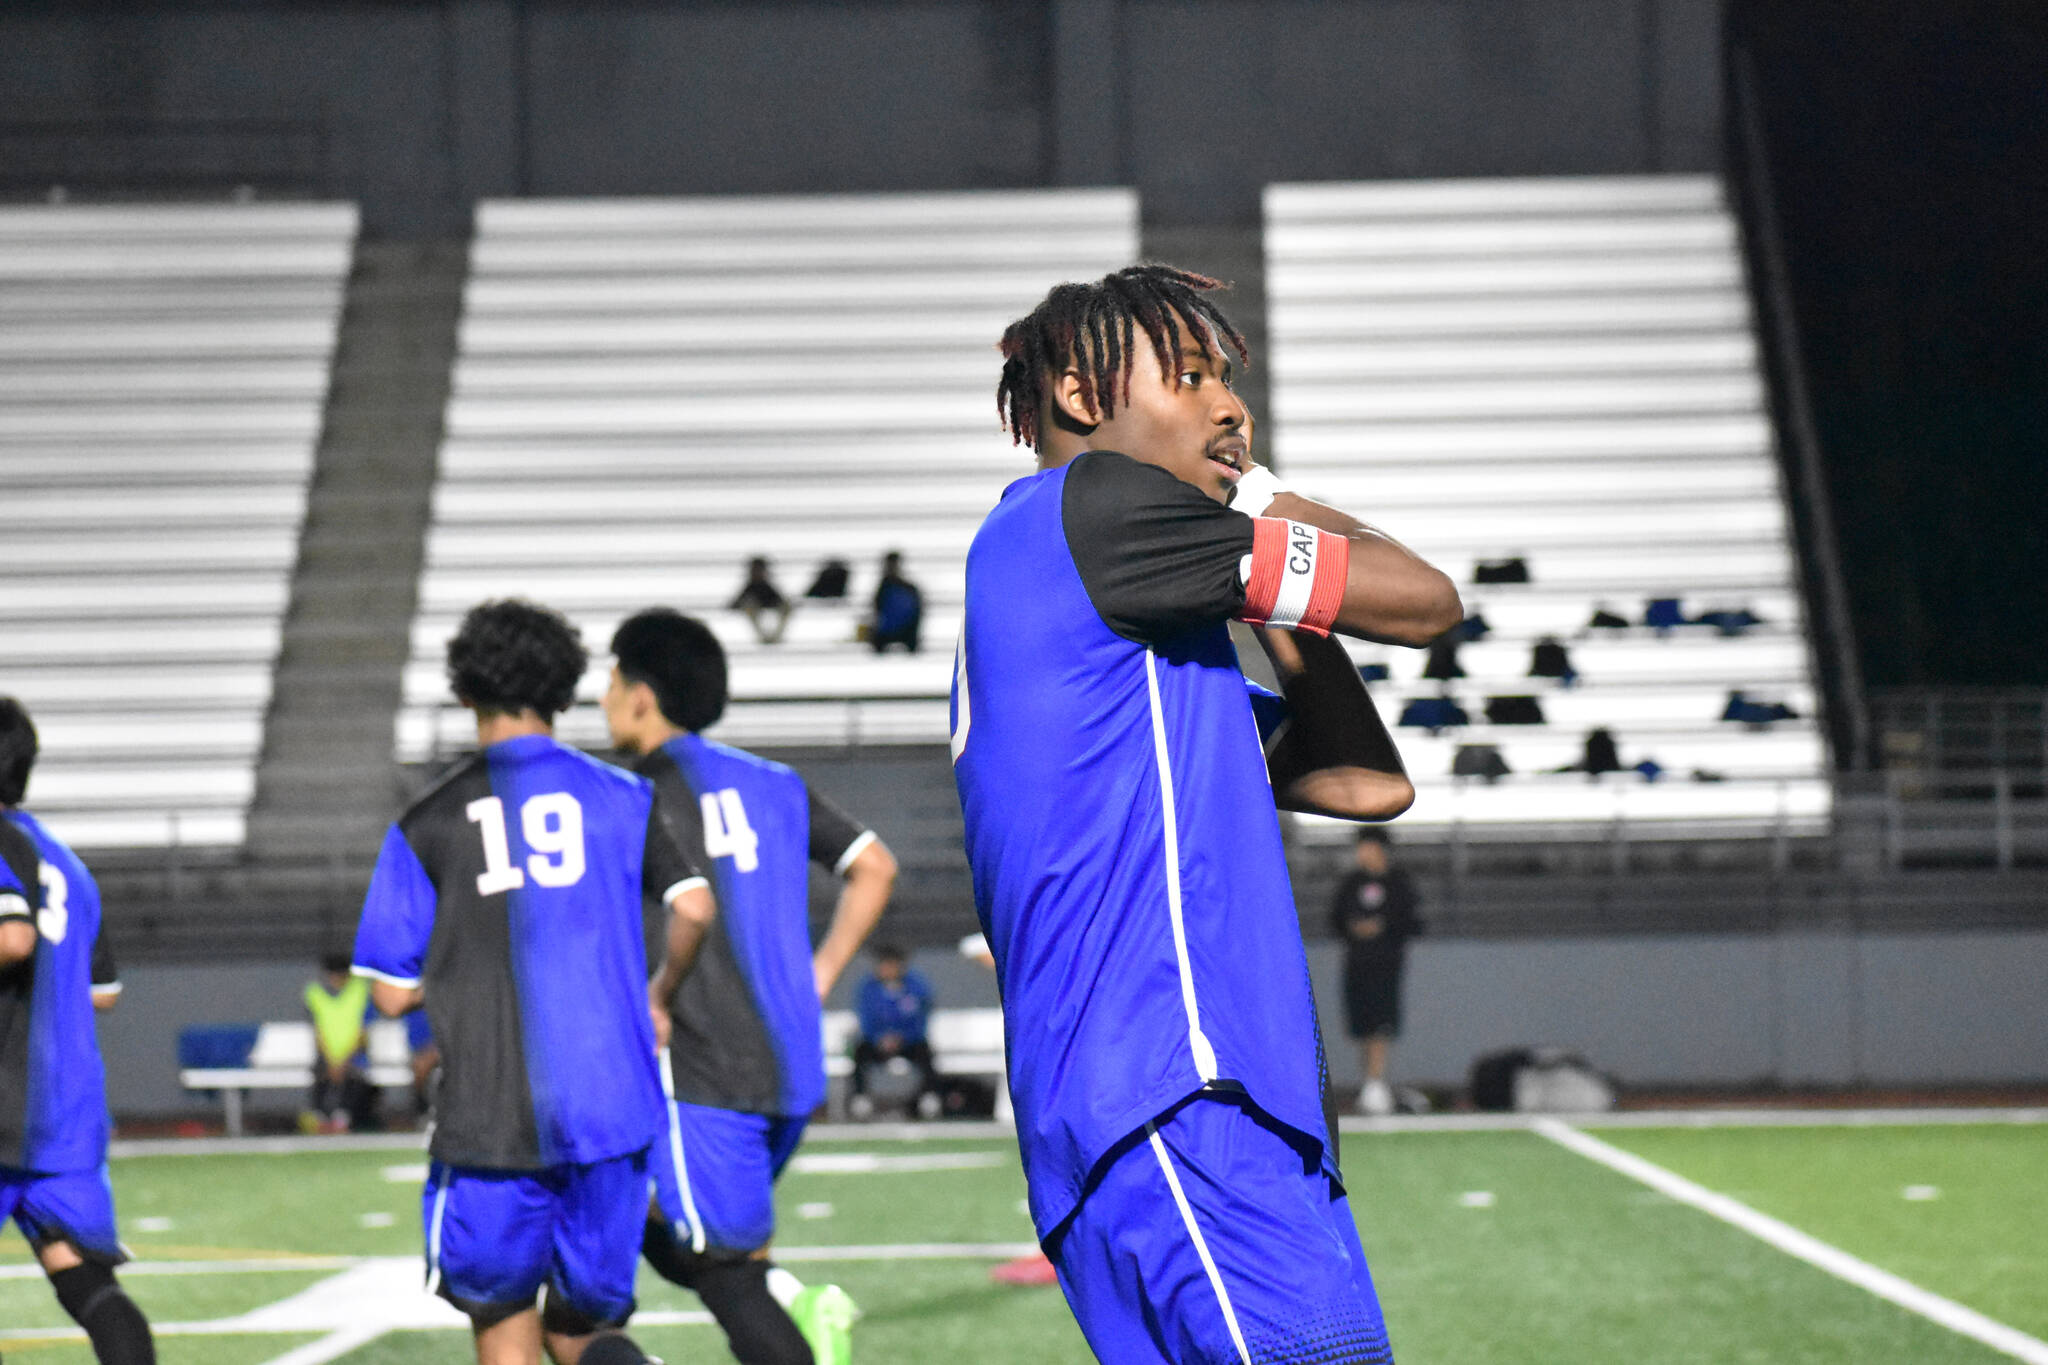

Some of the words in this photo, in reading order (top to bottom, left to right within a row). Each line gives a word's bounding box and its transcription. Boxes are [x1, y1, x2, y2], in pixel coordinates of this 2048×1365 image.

[1290, 522, 1313, 575] CAP
[466, 791, 586, 896] 19
[701, 788, 759, 873] 4
